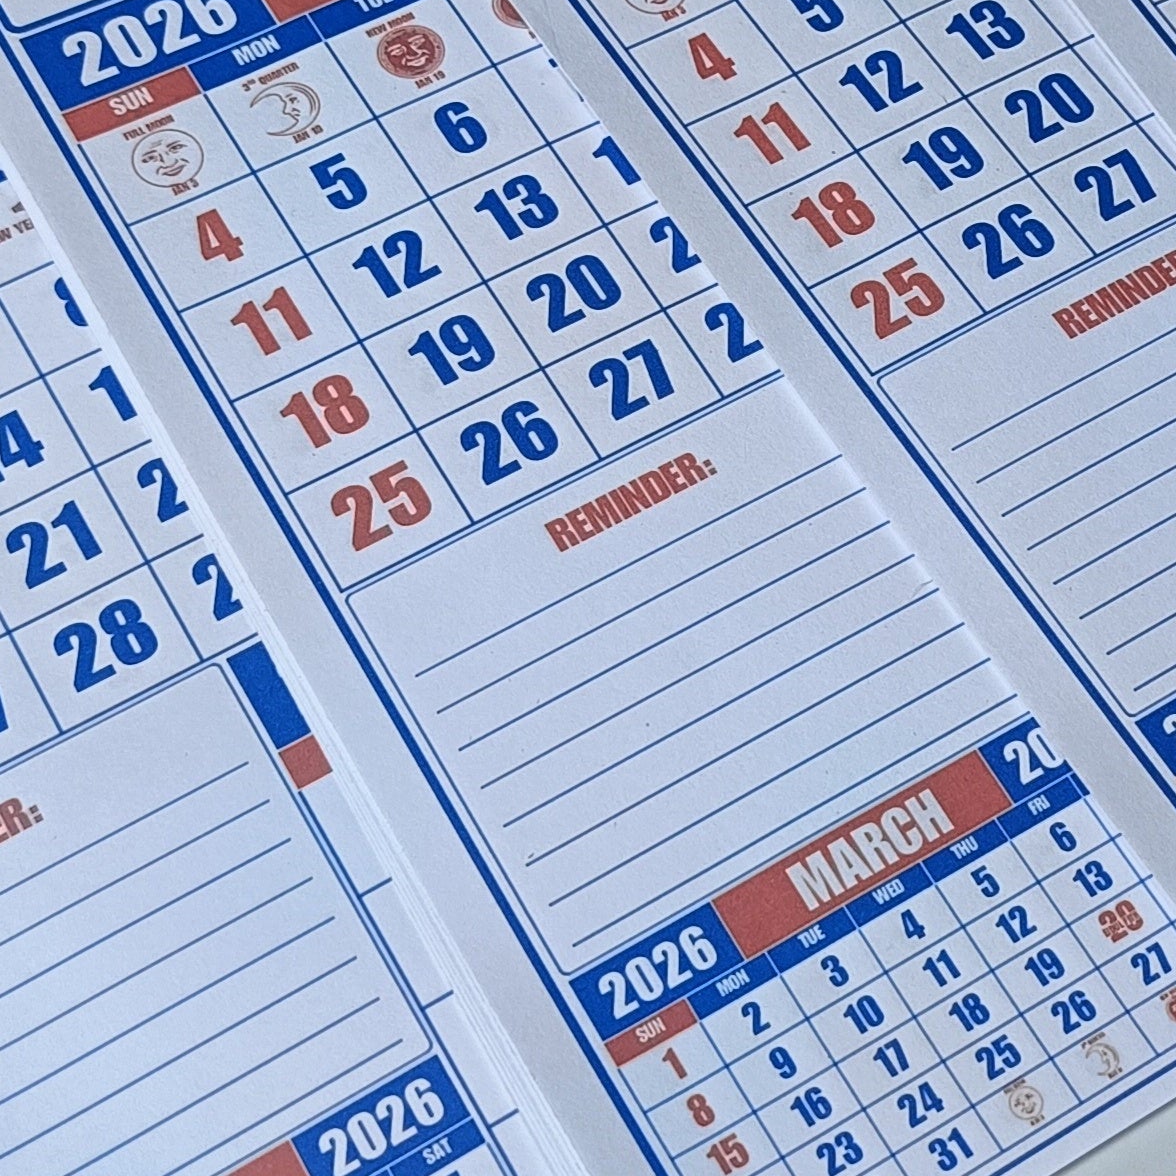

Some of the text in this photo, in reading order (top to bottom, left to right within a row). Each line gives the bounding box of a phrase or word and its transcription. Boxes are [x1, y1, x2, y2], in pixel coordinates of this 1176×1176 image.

[109, 86, 153, 116] SUN
[231, 34, 281, 66] MON
[841, 50, 923, 112] 12
[309, 153, 367, 209] 5
[792, 180, 877, 249] 18
[526, 255, 621, 333] 20
[849, 258, 945, 340] 25
[330, 461, 431, 552] 25
[542, 451, 718, 552] REMINDER:
[6, 500, 102, 589] 21
[54, 599, 158, 692] 28
[598, 788, 955, 1018] 2026 MARCH
[636, 793, 1052, 1044] SUN MON TUE WED THU FRI
[318, 1077, 446, 1176] 2026
[422, 1138, 454, 1166] SAT
